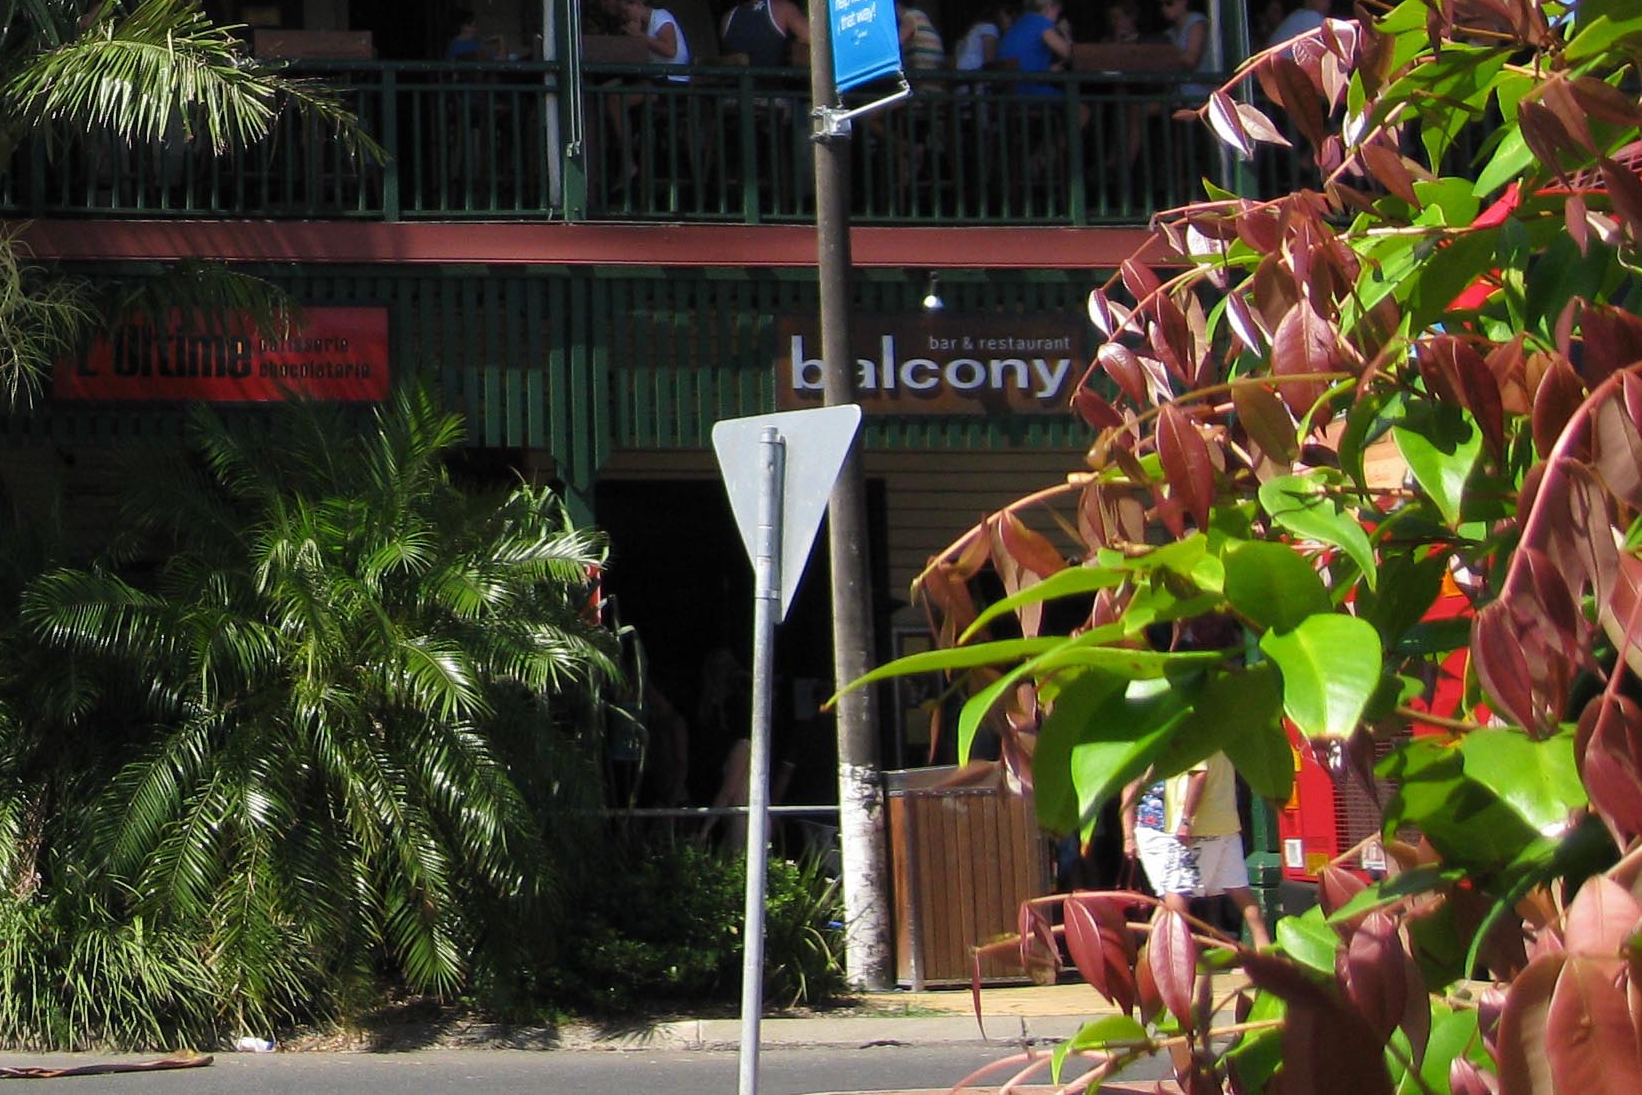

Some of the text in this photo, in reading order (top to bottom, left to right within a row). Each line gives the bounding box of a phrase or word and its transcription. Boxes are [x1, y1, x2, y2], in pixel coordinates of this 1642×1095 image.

[929, 335, 1071, 351] bar & restaurant
[790, 334, 1071, 399] balcony
